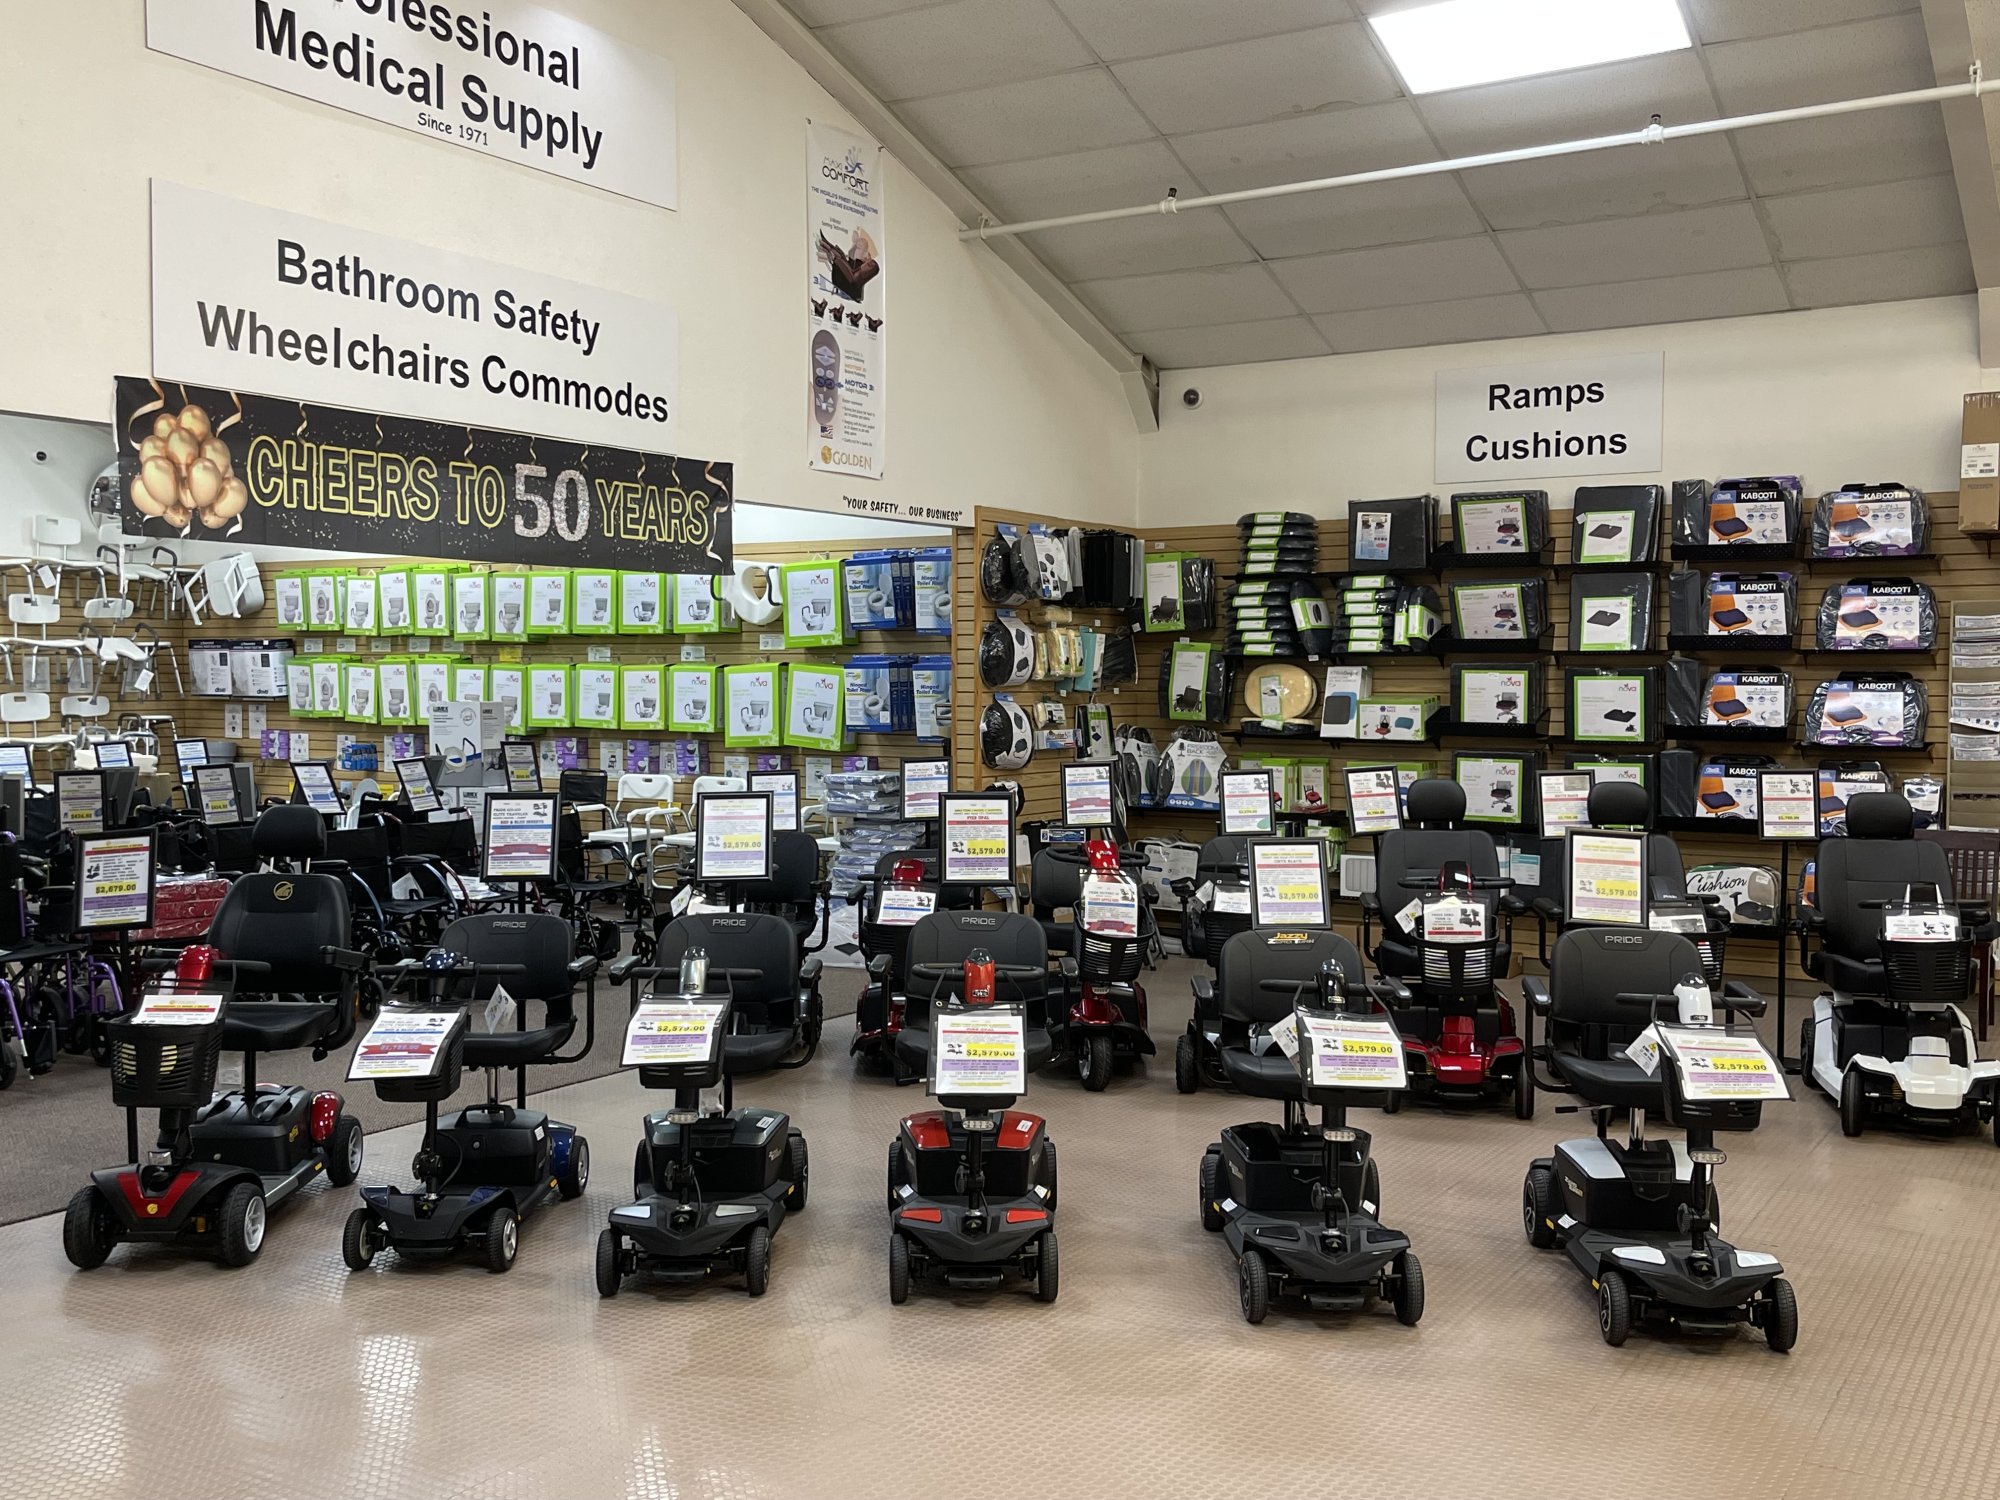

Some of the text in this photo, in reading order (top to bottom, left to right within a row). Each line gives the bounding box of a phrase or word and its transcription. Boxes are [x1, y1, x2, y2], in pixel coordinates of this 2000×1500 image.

[335, 0, 580, 90] essional
[255, 0, 603, 170] Medical Supply
[417, 112, 489, 146] Since 1971
[821, 165, 869, 193] COMFORT
[277, 238, 601, 356] Bathroom Safety
[196, 301, 669, 423] Wheelchairs Commodes
[844, 378, 868, 390] MOTOR
[1488, 382, 1605, 412] Ramps
[1465, 430, 1628, 462] Cushions
[832, 450, 872, 471] GOLDEN
[246, 434, 710, 546] CHEERS TO 50 YEARS
[1740, 491, 1777, 500] KABOOTI
[1863, 491, 1903, 500] KABOOTI
[908, 506, 924, 518] OUR
[1501, 506, 1518, 514] nova
[593, 579, 608, 589] nova
[640, 579, 656, 588] nova
[811, 575, 829, 585] nova
[1740, 583, 1777, 592] KABOOTI
[1872, 586, 1911, 595] KABOOTI
[547, 675, 562, 683] nova
[595, 675, 611, 684] nova
[640, 675, 656, 685] nova
[692, 676, 707, 686] nova
[750, 678, 768, 687] nova
[1501, 679, 1521, 687] nova
[1741, 675, 1778, 683] KABOOTI
[816, 680, 834, 690] nova
[1857, 682, 1896, 690] KABOOTI
[1496, 768, 1516, 777] nova
[1618, 772, 1637, 780] nova
[1729, 767, 1757, 776] KABOO
[1840, 772, 1878, 780] KABOOTI
[967, 847, 1006, 855] $2,579.00
[1686, 870, 1748, 893] Cushion
[96, 884, 137, 895] $2,679.00
[1595, 887, 1638, 897] $2,579.00
[1278, 892, 1319, 900] $2,579.00
[492, 921, 527, 929] PRIDE
[712, 918, 747, 927] PRIDE
[961, 916, 996, 926] PRIDE
[1273, 932, 1308, 941] Jazzy
[1604, 935, 1643, 944] PRIDE
[1342, 1045, 1393, 1053] $2,579.00
[1713, 1062, 1767, 1071] $2,579.00
